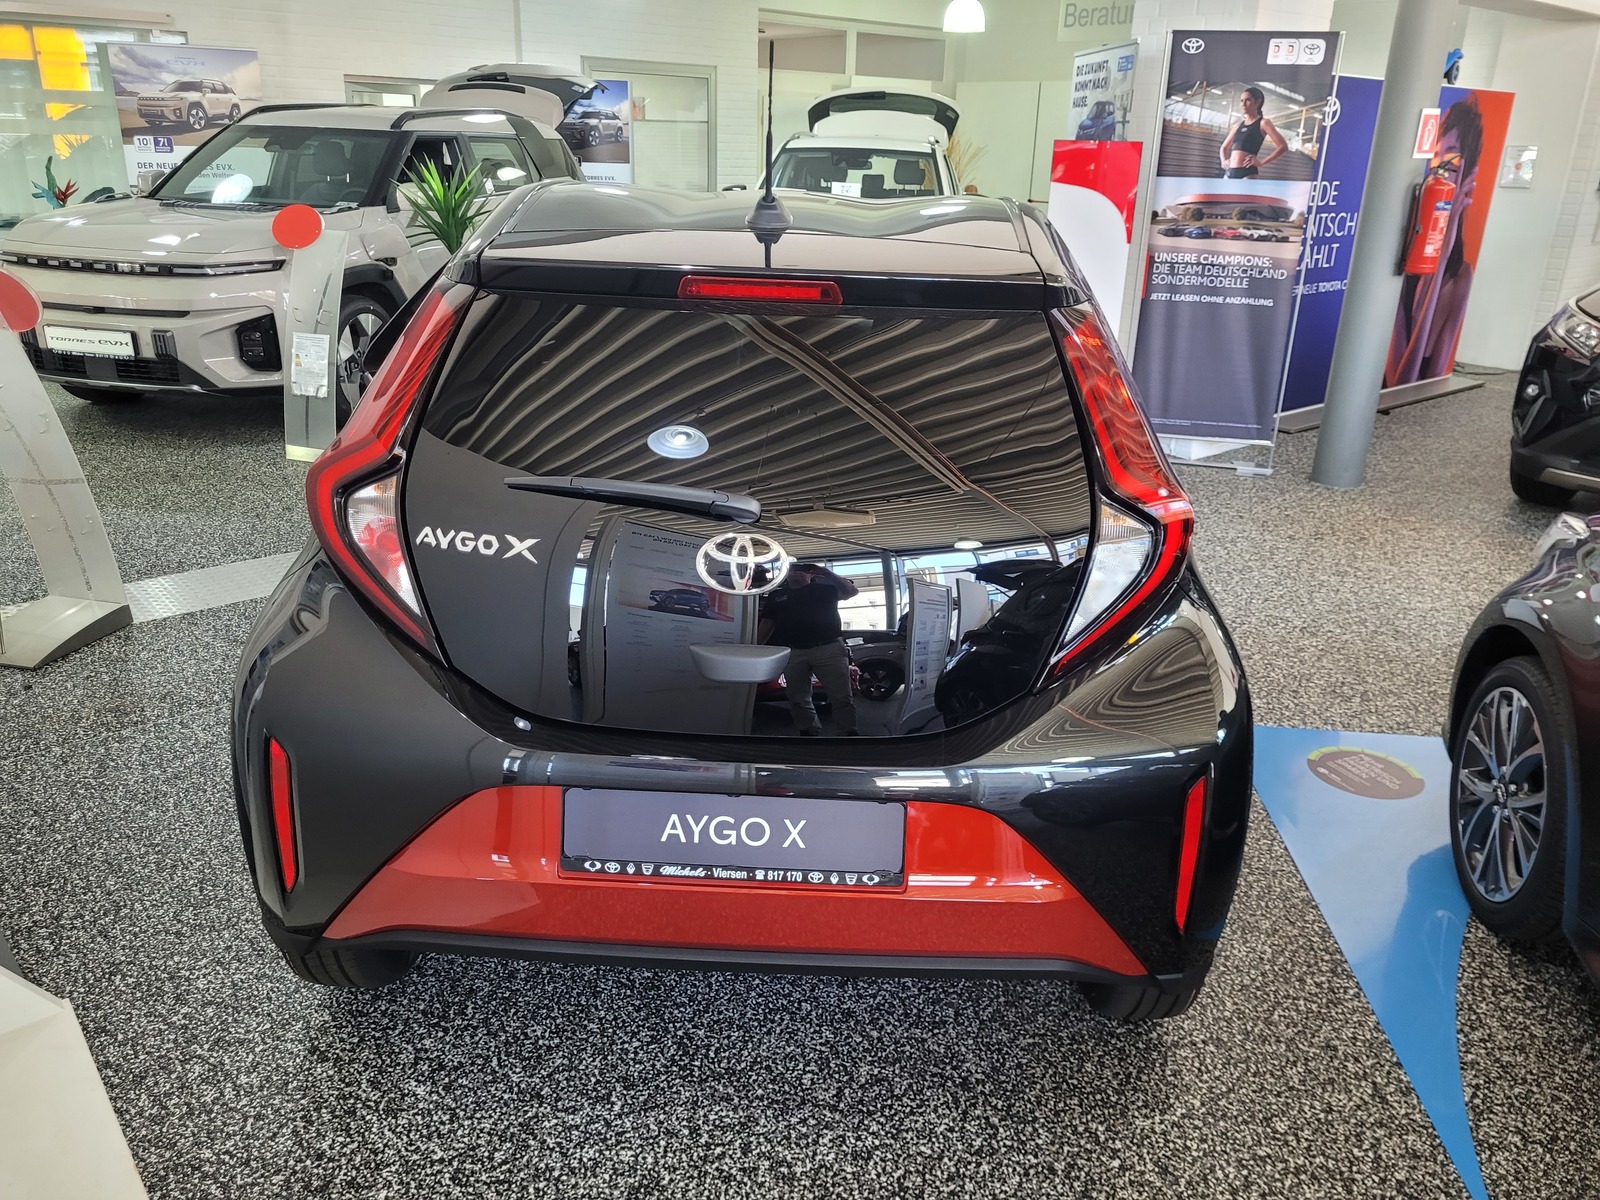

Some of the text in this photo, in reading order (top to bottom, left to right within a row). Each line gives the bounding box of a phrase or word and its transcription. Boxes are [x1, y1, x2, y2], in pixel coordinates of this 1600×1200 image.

[1085, 59, 1110, 76] ZUKUNFT
[1074, 76, 1109, 93] KOMMT NACH
[137, 137, 149, 147] 10
[137, 161, 155, 170] DER
[1154, 252, 1273, 268] UNSERE CHAMPIONS:
[1152, 263, 1288, 280] DIE TEAM DEUTSCHLAND
[1151, 274, 1250, 289] SONDERMODELLE
[1150, 292, 1274, 307] JETZT LEASEN OHNE ANZAHLUNG
[49, 335, 96, 345] TORRES
[415, 526, 541, 564] AYGO X
[660, 813, 807, 849] AYGO X
[659, 865, 803, 882] Michels Viersen 817 170
